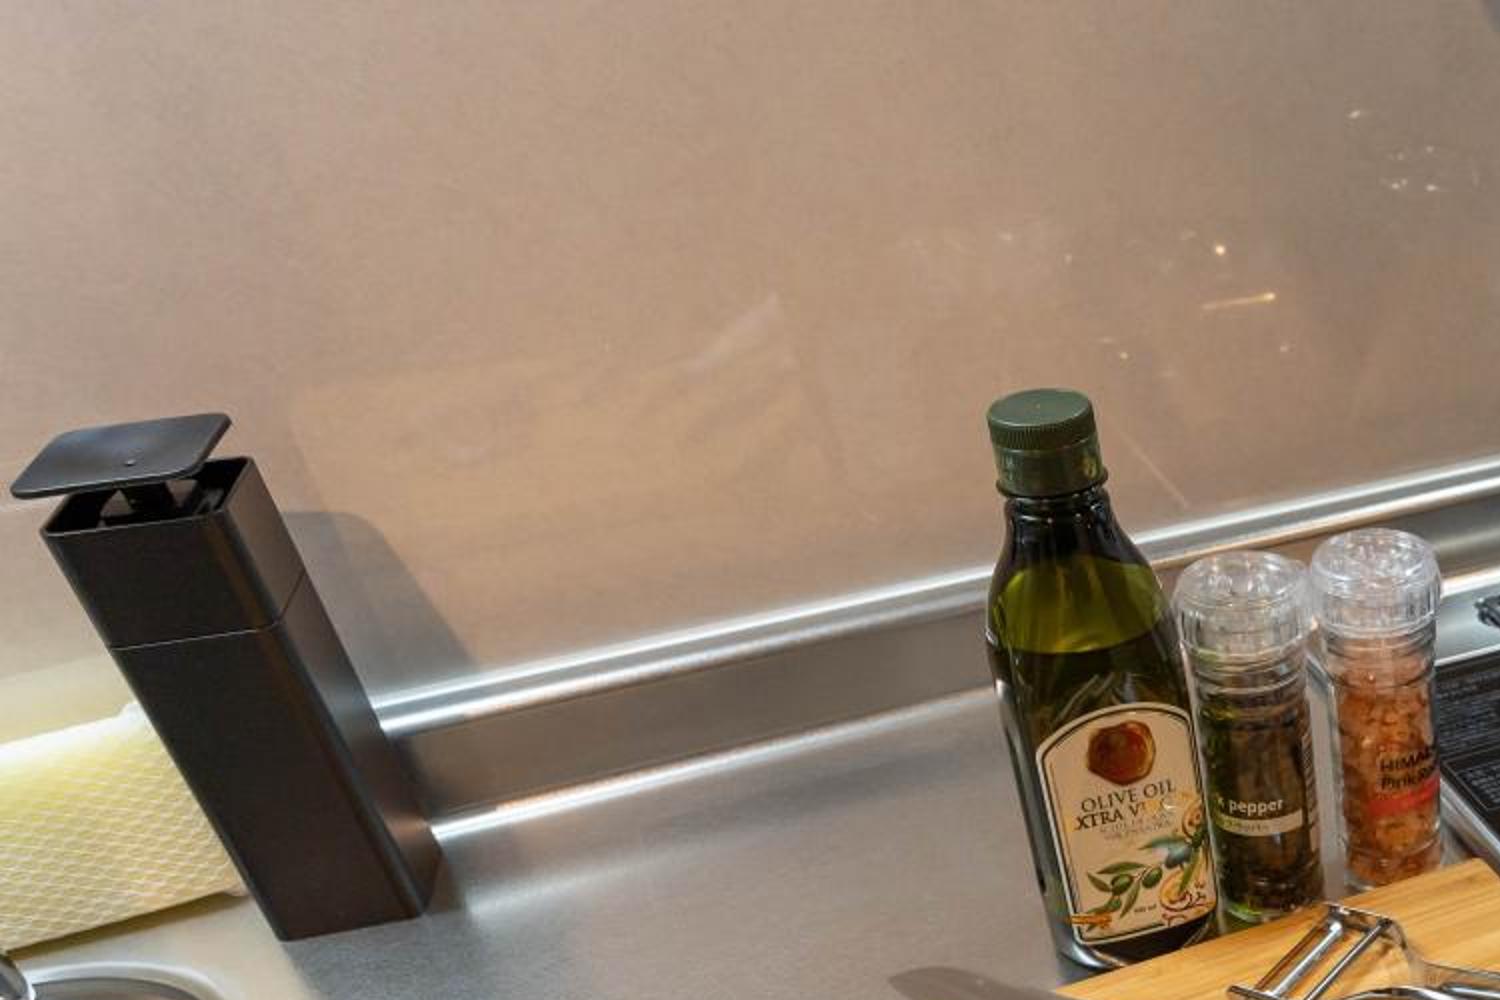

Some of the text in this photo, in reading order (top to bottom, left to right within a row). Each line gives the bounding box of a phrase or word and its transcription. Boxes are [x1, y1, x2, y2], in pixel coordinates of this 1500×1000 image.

[1081, 788, 1138, 813] OLIVE
[1142, 778, 1176, 799] OIL
[1228, 798, 1284, 817] pepper
